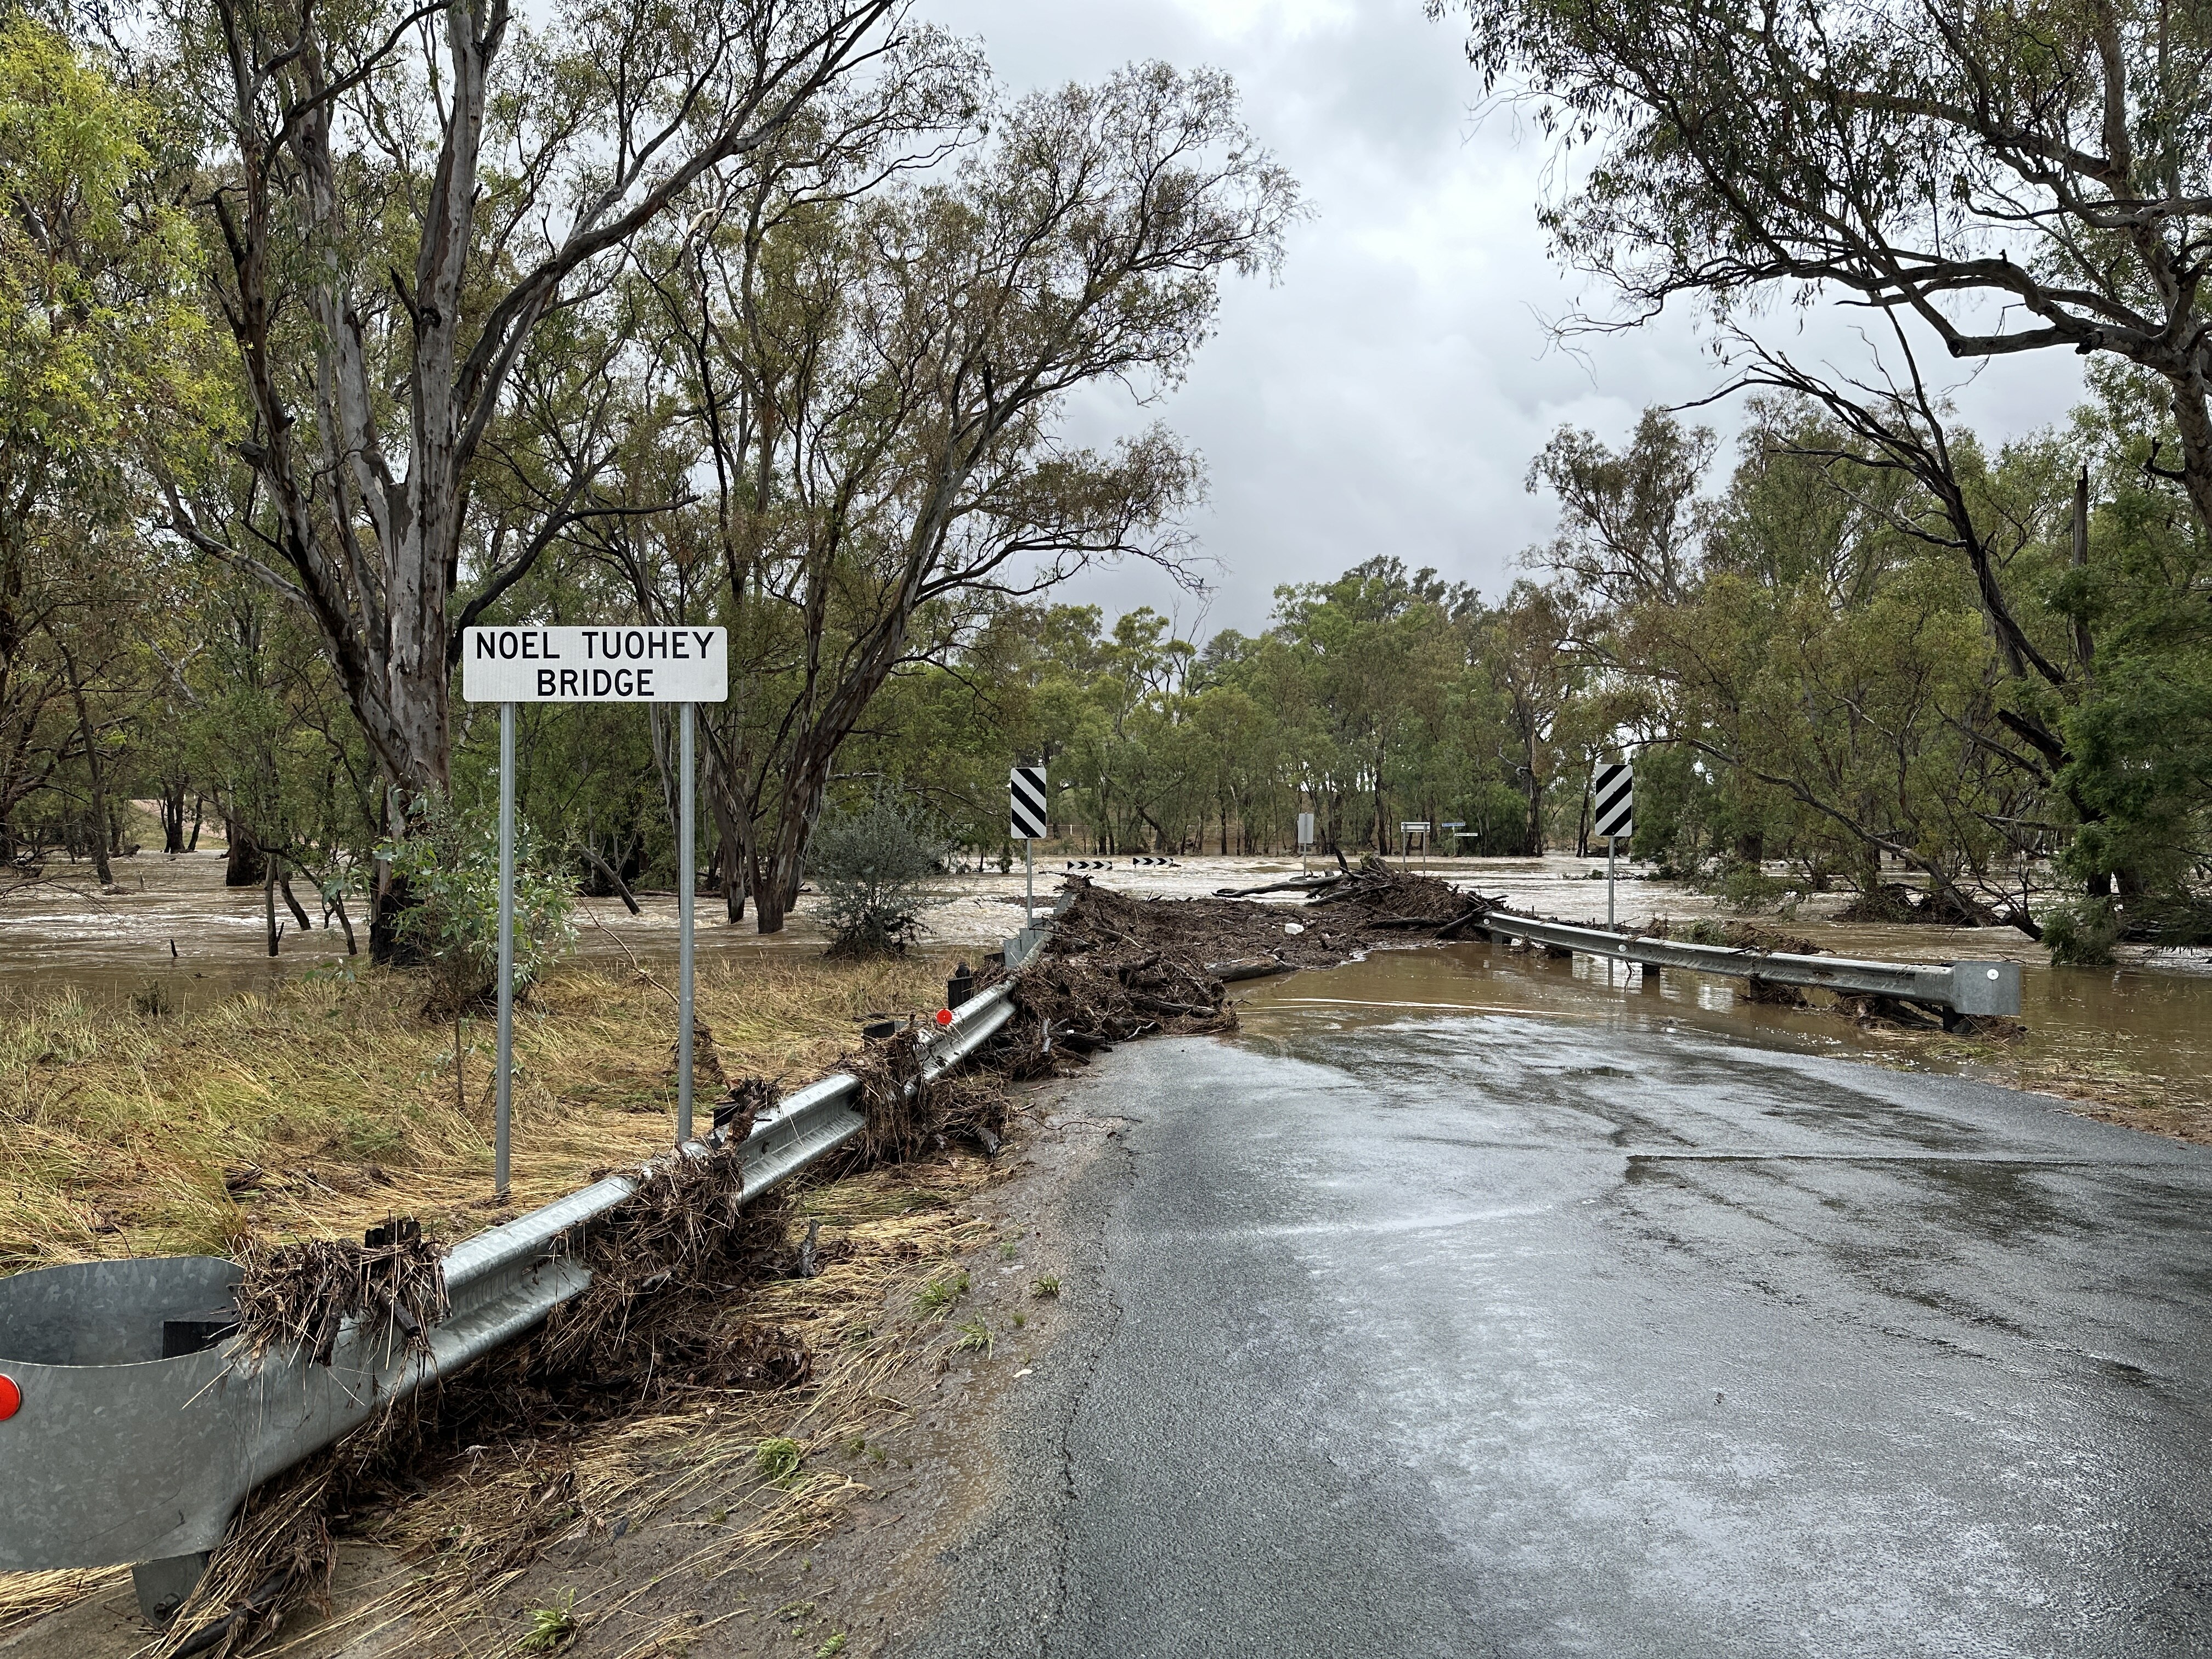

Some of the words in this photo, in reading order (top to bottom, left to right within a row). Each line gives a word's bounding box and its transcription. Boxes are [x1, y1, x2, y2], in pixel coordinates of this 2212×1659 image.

[477, 631, 560, 659] NOEL
[582, 631, 715, 659] TUOHEY
[537, 669, 654, 696] BRIDGE
